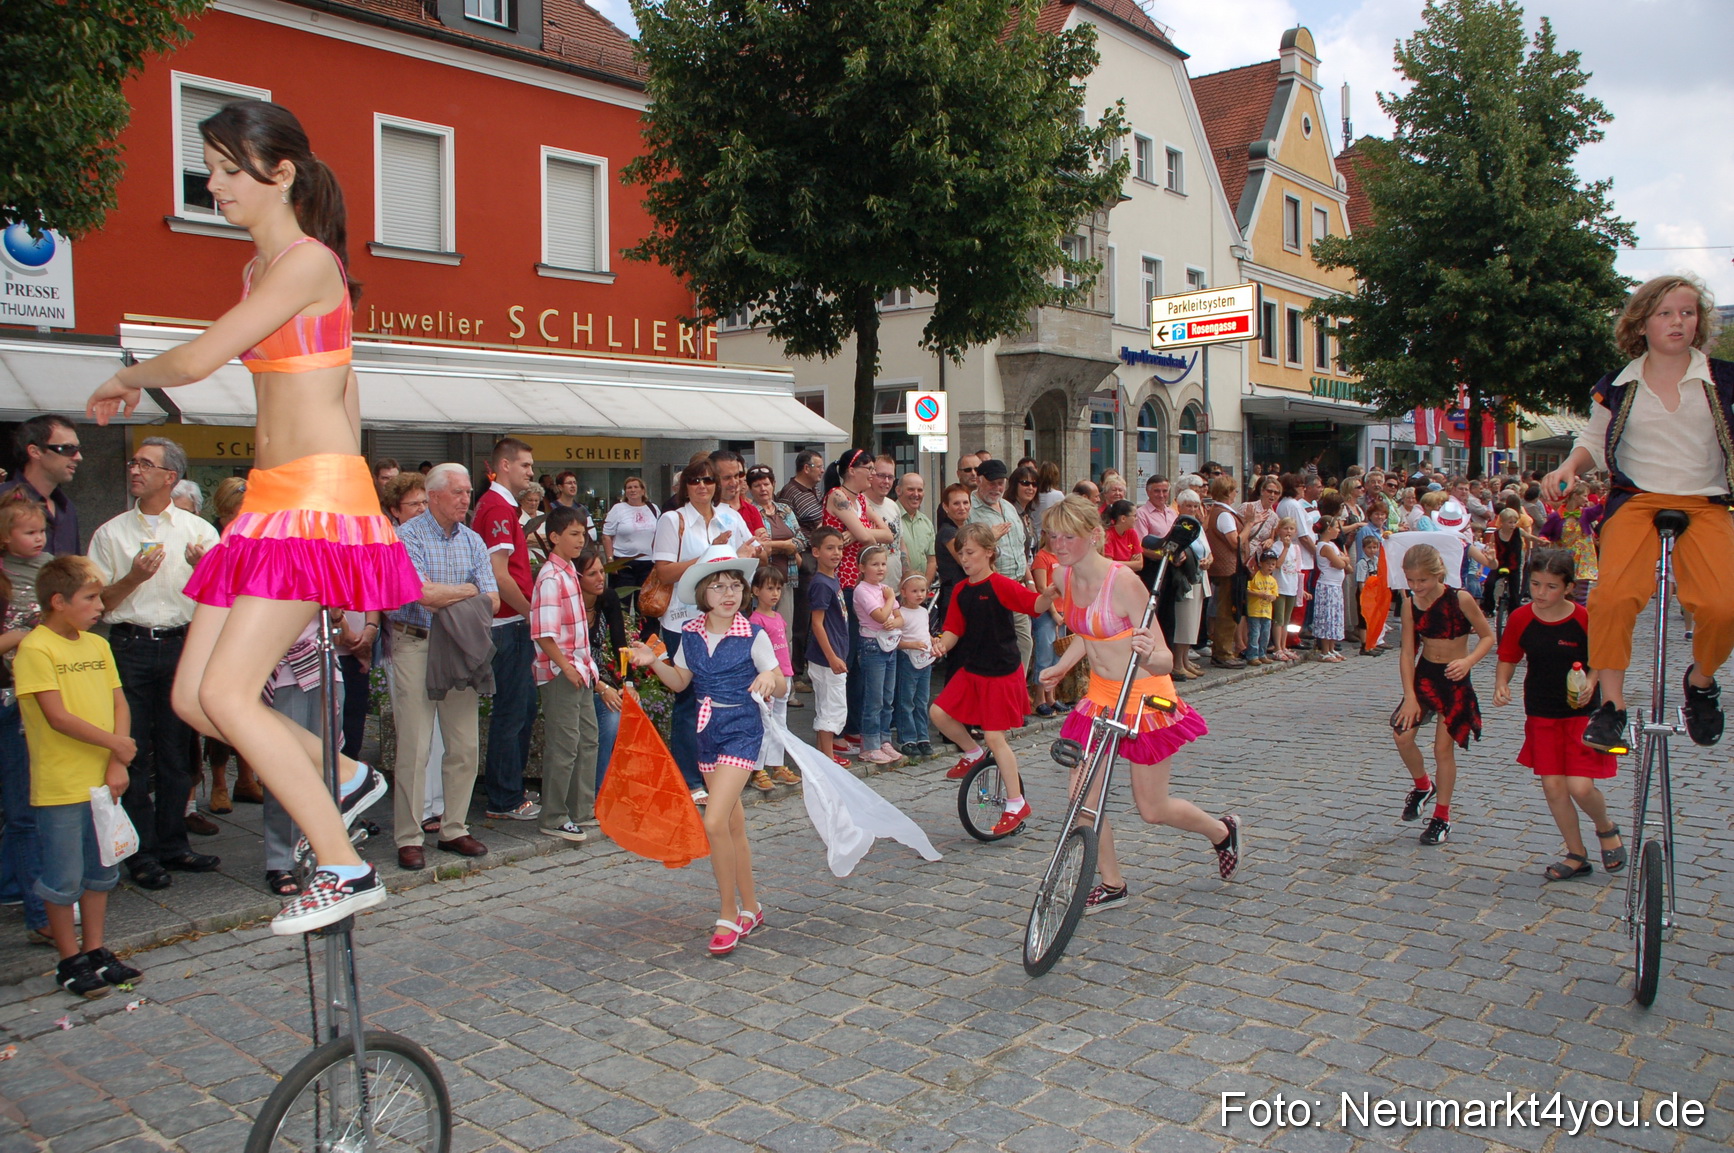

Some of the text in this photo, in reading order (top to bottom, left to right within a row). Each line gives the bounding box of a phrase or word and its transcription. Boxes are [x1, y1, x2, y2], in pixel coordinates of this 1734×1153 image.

[5, 282, 60, 299] PRESSE
[0, 302, 65, 319] THUMANN
[1168, 296, 1236, 315] Parkleitsystem
[368, 304, 718, 355] juwelier SCHLIERF
[1176, 320, 1237, 339] P Rosengasse
[566, 448, 640, 460] SCHLIERF
[671, 611, 688, 621] START
